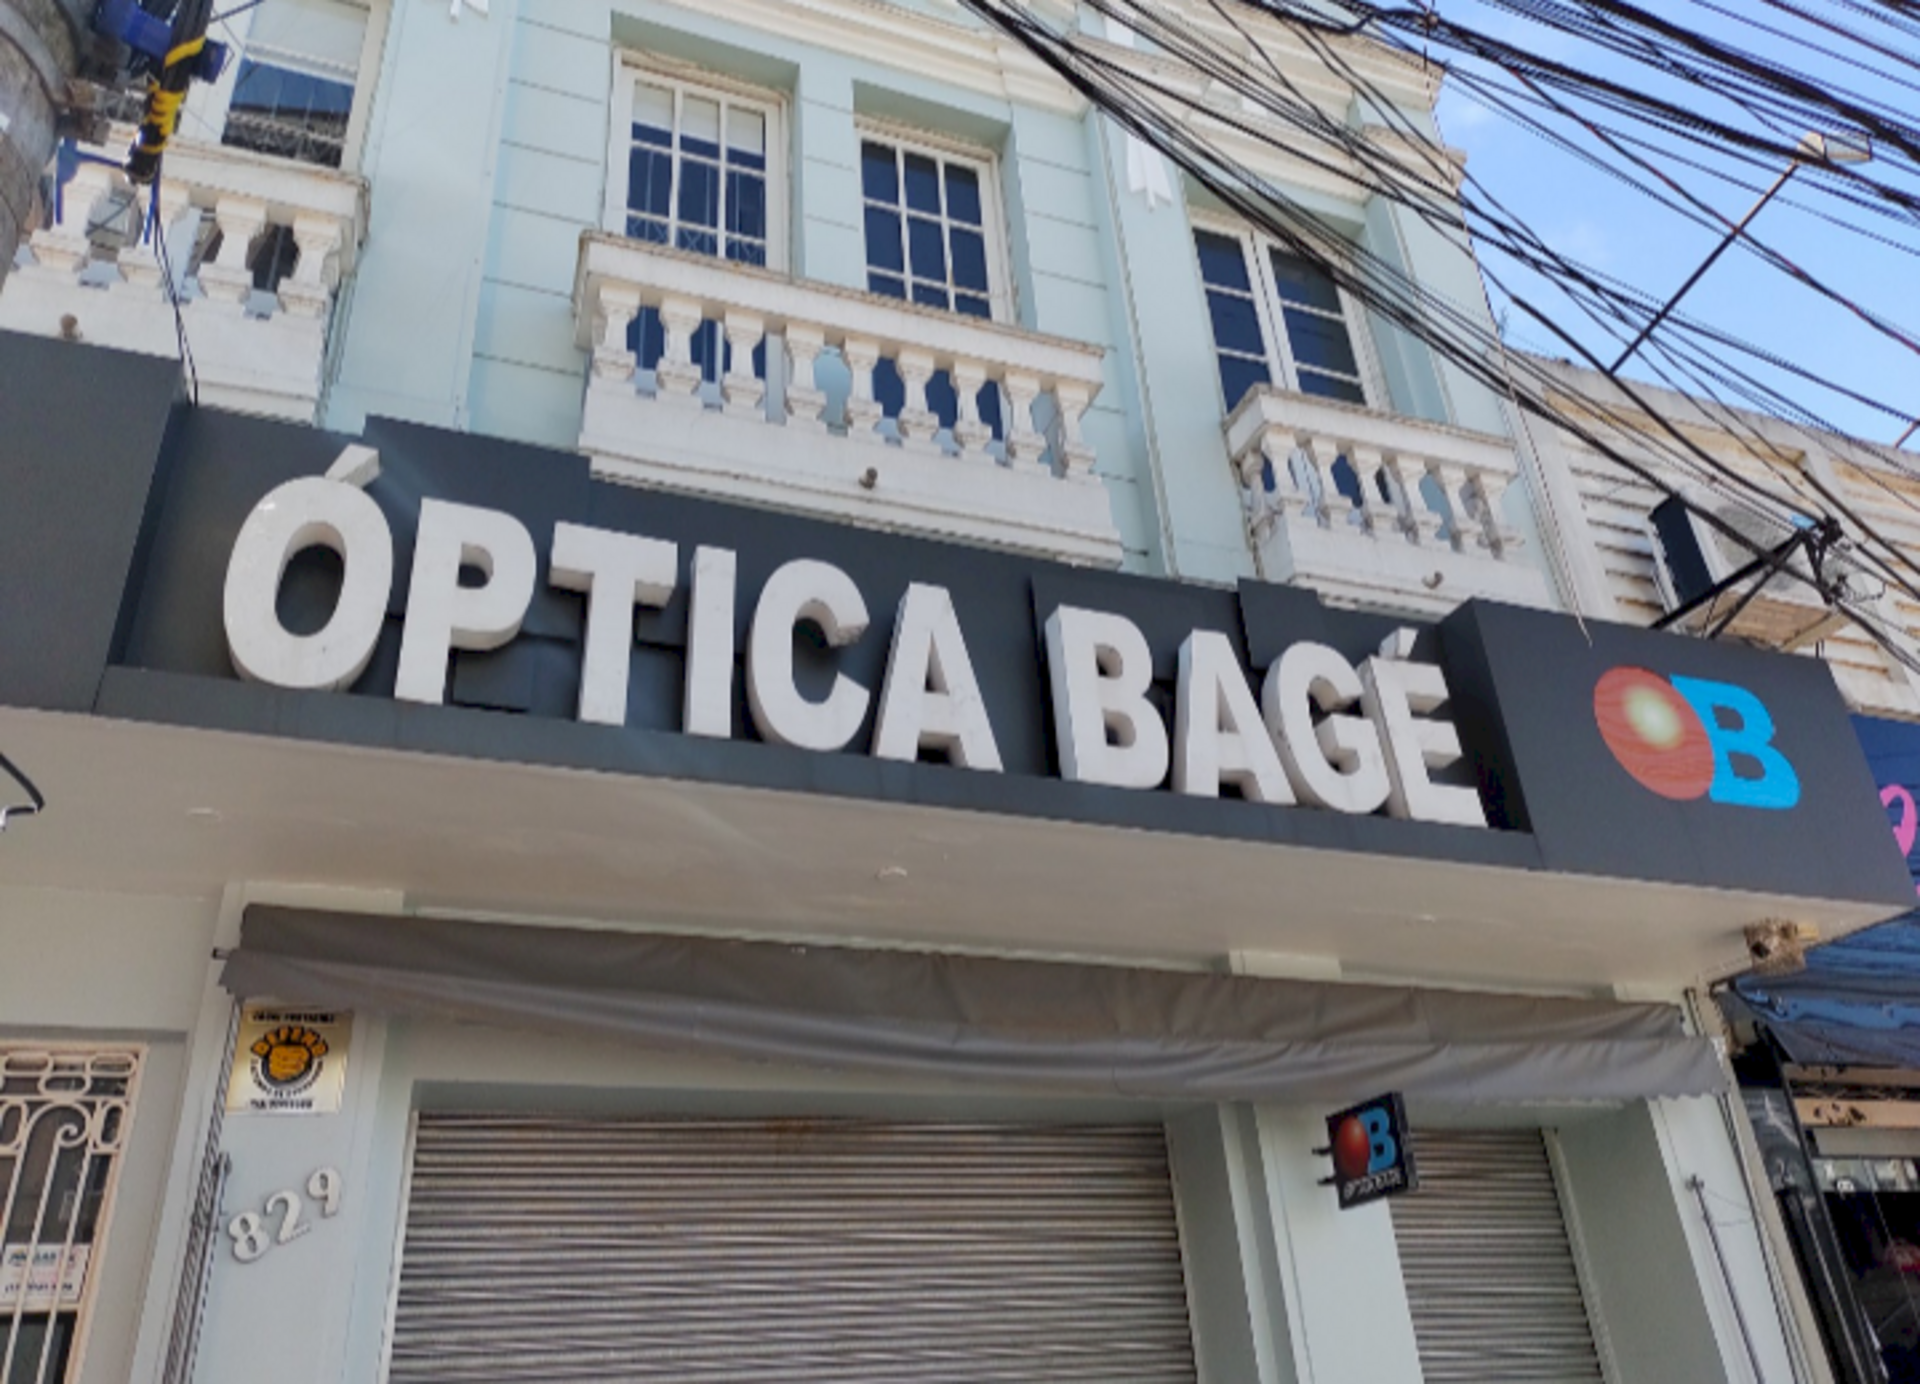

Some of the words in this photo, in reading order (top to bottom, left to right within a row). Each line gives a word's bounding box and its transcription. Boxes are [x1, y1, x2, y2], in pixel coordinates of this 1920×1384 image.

[223, 443, 1004, 773] ÓPTICA
[1045, 602, 1489, 829] BAGÉ
[228, 1165, 342, 1264] 829
